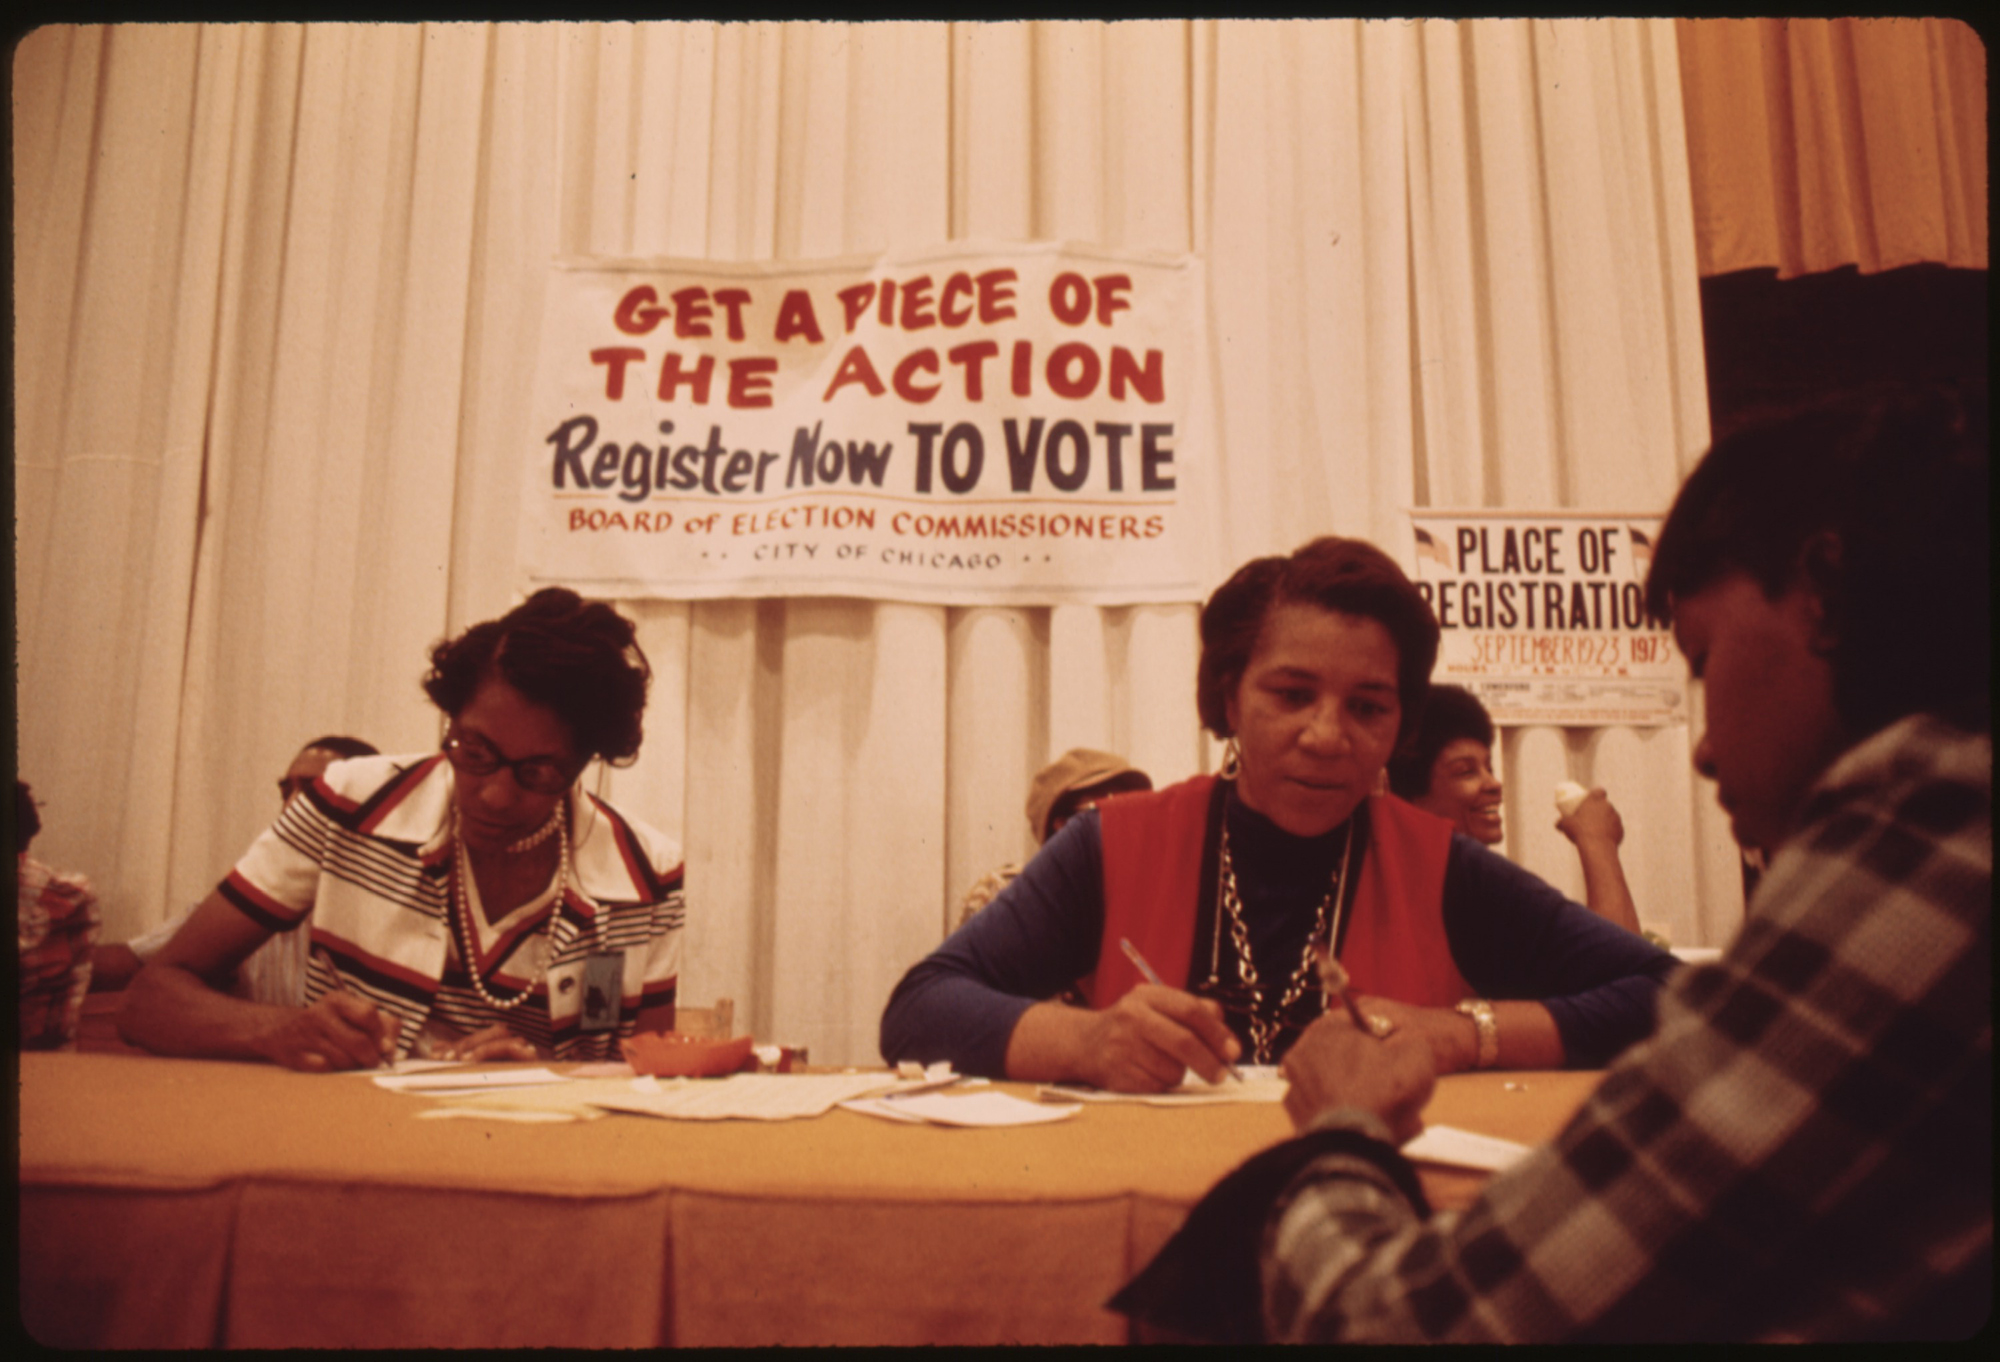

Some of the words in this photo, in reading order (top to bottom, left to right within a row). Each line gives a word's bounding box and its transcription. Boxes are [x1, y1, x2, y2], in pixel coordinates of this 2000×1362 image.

[613, 284, 752, 342] GET
[774, 289, 825, 344] A
[836, 268, 1018, 334] PIECE
[1048, 271, 1132, 327] OF
[589, 346, 778, 409] THE
[822, 340, 1165, 405] ACTION
[546, 415, 780, 503] Register
[785, 420, 893, 488] Now
[907, 421, 985, 494] TO
[1002, 418, 1176, 493] VOTE
[568, 507, 673, 534] BOARD
[683, 513, 721, 535] of
[731, 505, 875, 536] ELECTION
[892, 512, 1165, 540] COMMISSIONERS
[754, 543, 819, 560] CITY
[836, 544, 869, 560] OF
[881, 548, 1002, 569] CHICAGO
[1456, 526, 1565, 574] PLACE
[1578, 526, 1620, 575] OF
[1471, 634, 1574, 665] SEPTEMBER
[1629, 636, 1671, 664] 1973
